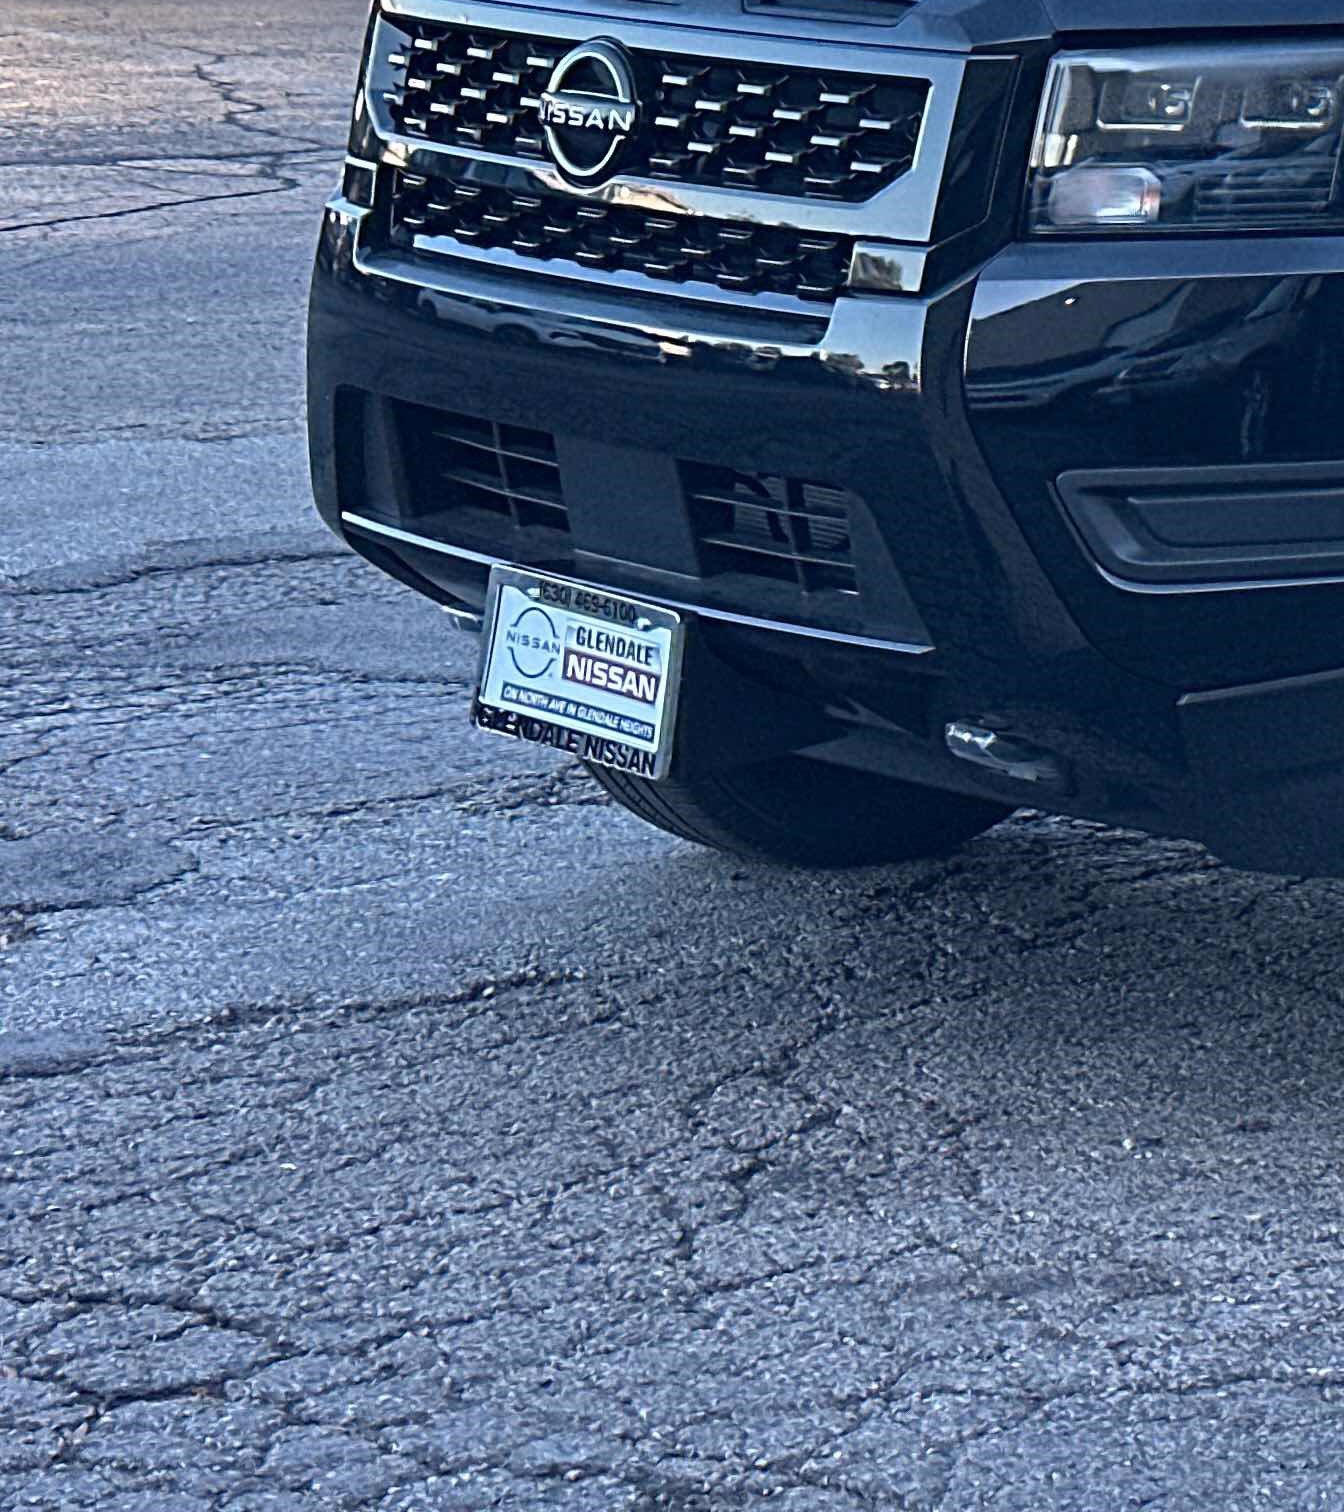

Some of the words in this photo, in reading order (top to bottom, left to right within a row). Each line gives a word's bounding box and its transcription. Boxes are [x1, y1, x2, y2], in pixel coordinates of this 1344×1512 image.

[539, 98, 633, 132] NISSAN
[506, 630, 560, 656] NISSAN
[576, 625, 654, 666] GLENDALE
[566, 653, 656, 702] NISSAN
[503, 686, 517, 700] ON
[518, 689, 548, 708] NORTH
[549, 697, 568, 713] AVE
[577, 705, 620, 729] GLENDALE
[620, 718, 654, 739] HEIGHTS
[584, 737, 656, 777] NISSAN
